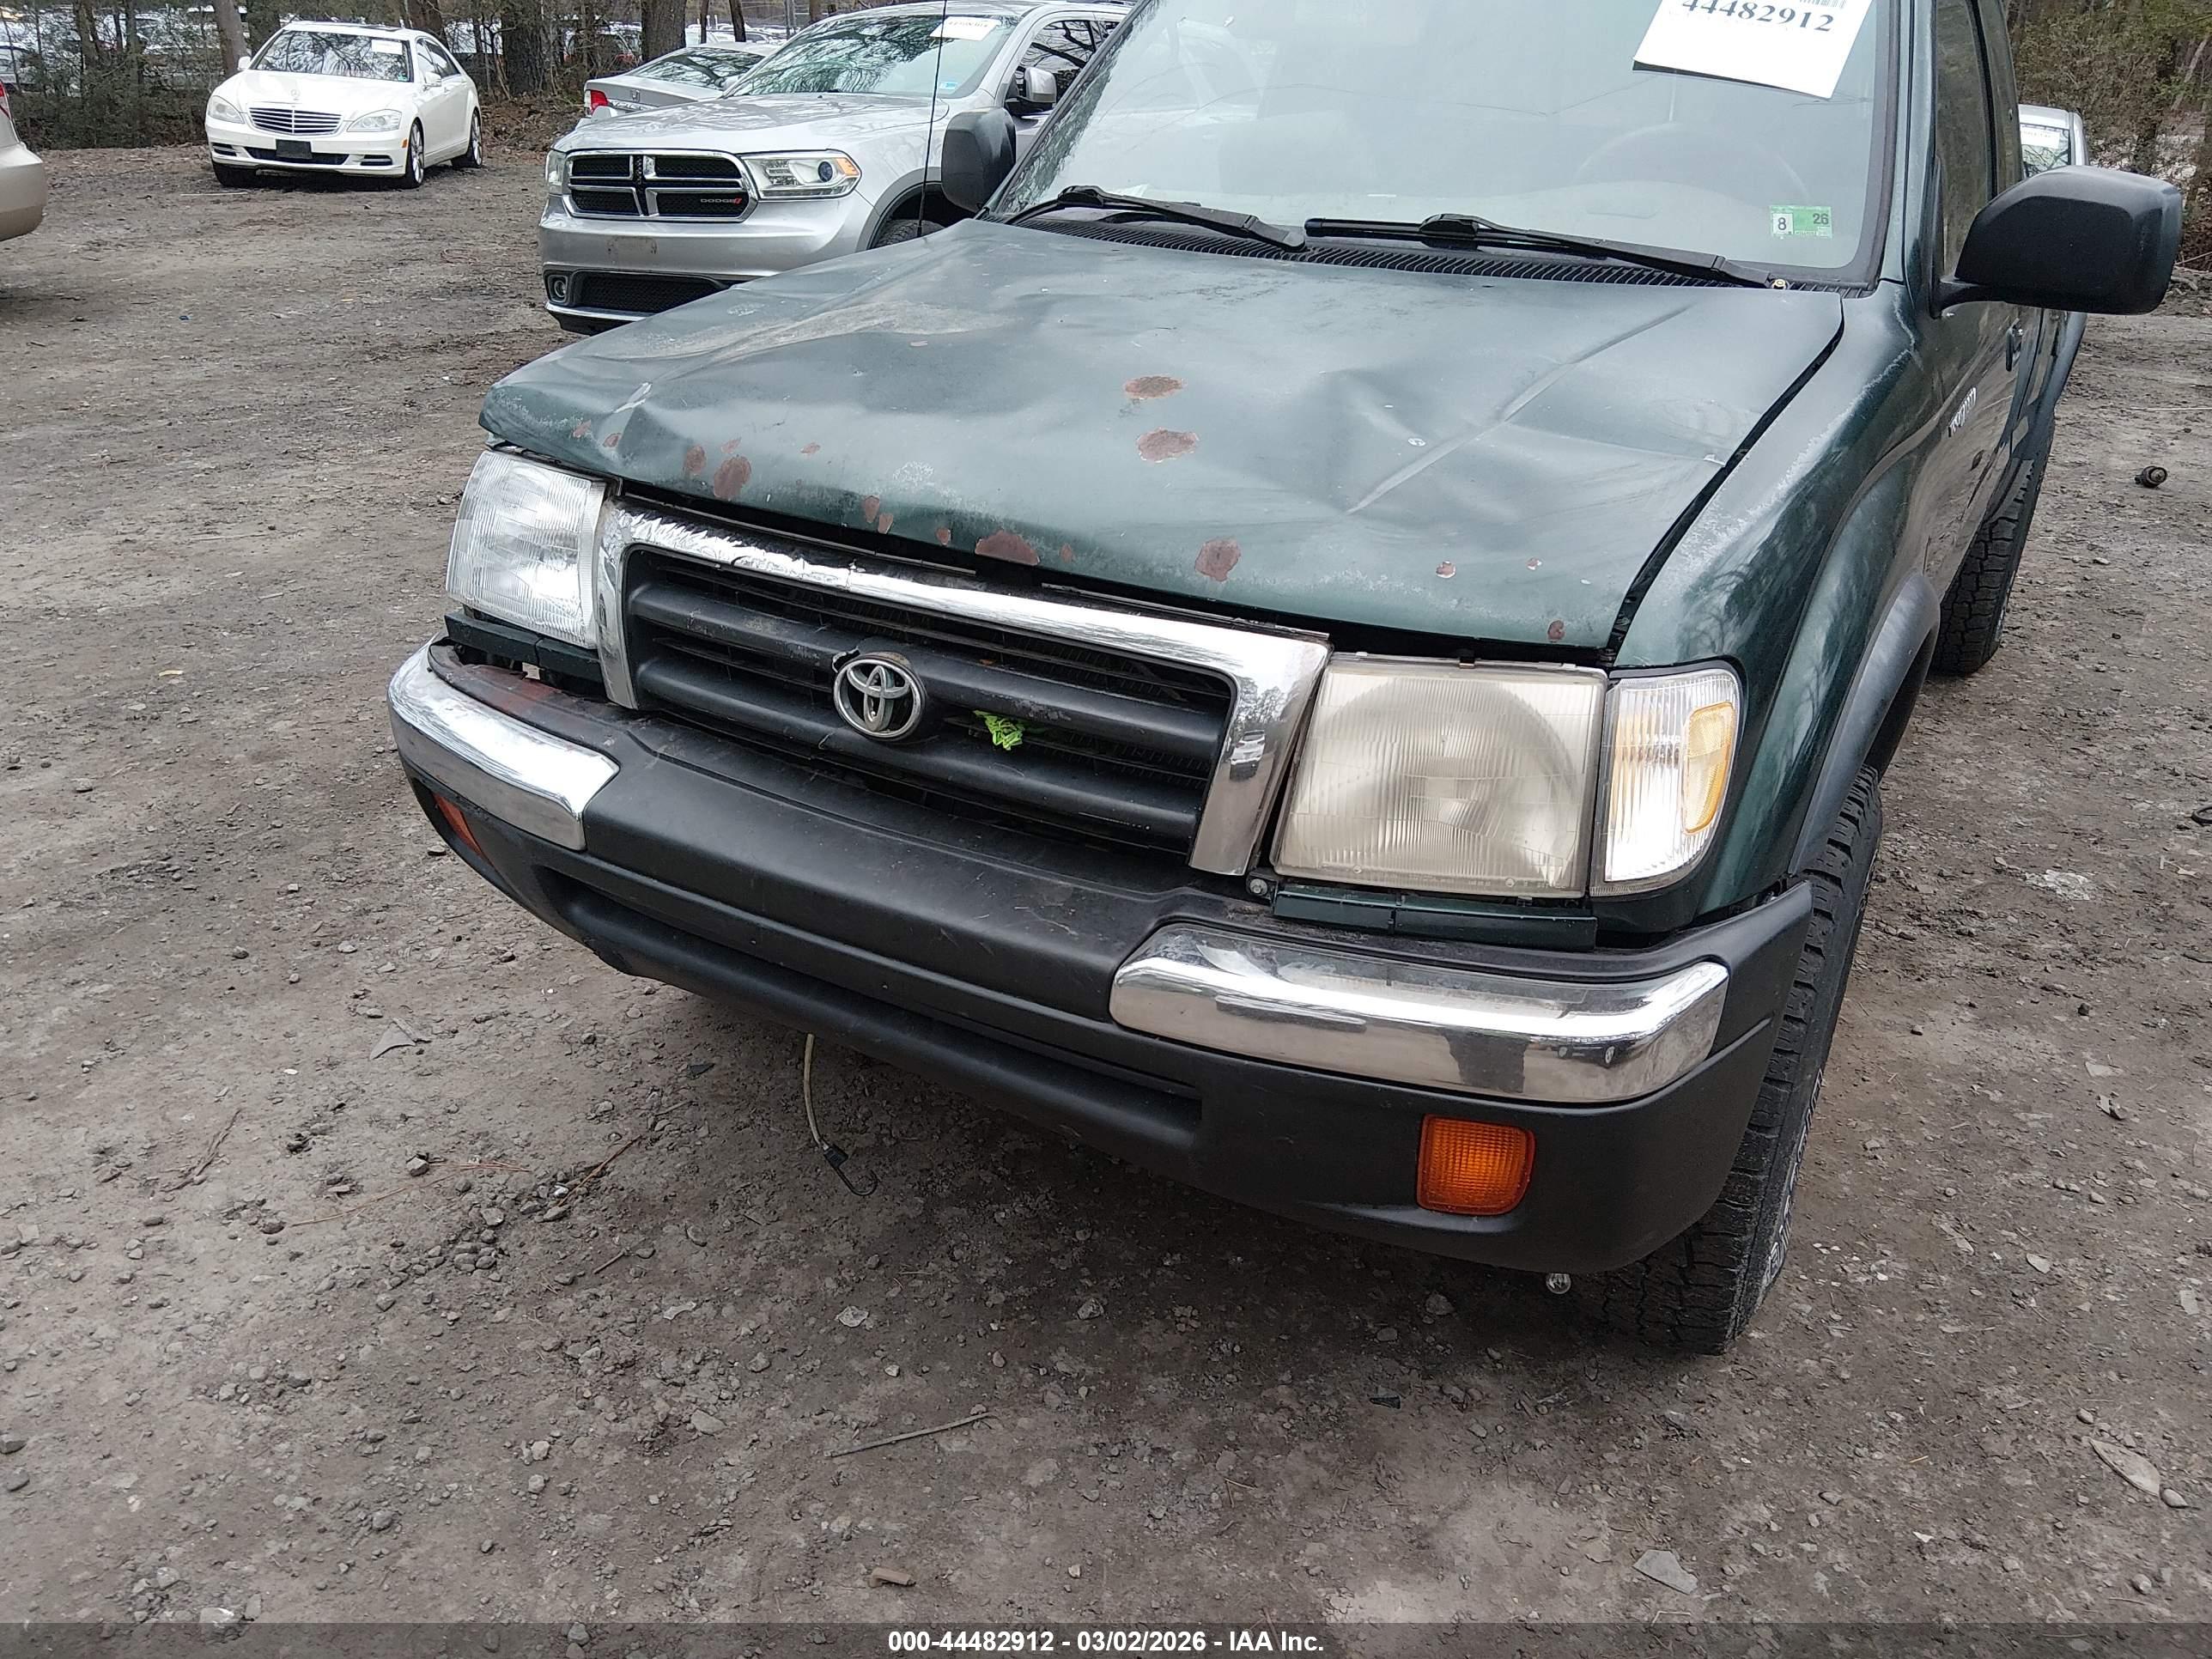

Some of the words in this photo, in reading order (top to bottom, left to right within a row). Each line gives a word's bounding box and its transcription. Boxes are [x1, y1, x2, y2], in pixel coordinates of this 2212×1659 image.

[1681, 0, 1834, 32] 44482912
[1778, 216, 1787, 231] 8
[1813, 212, 1829, 225] 26
